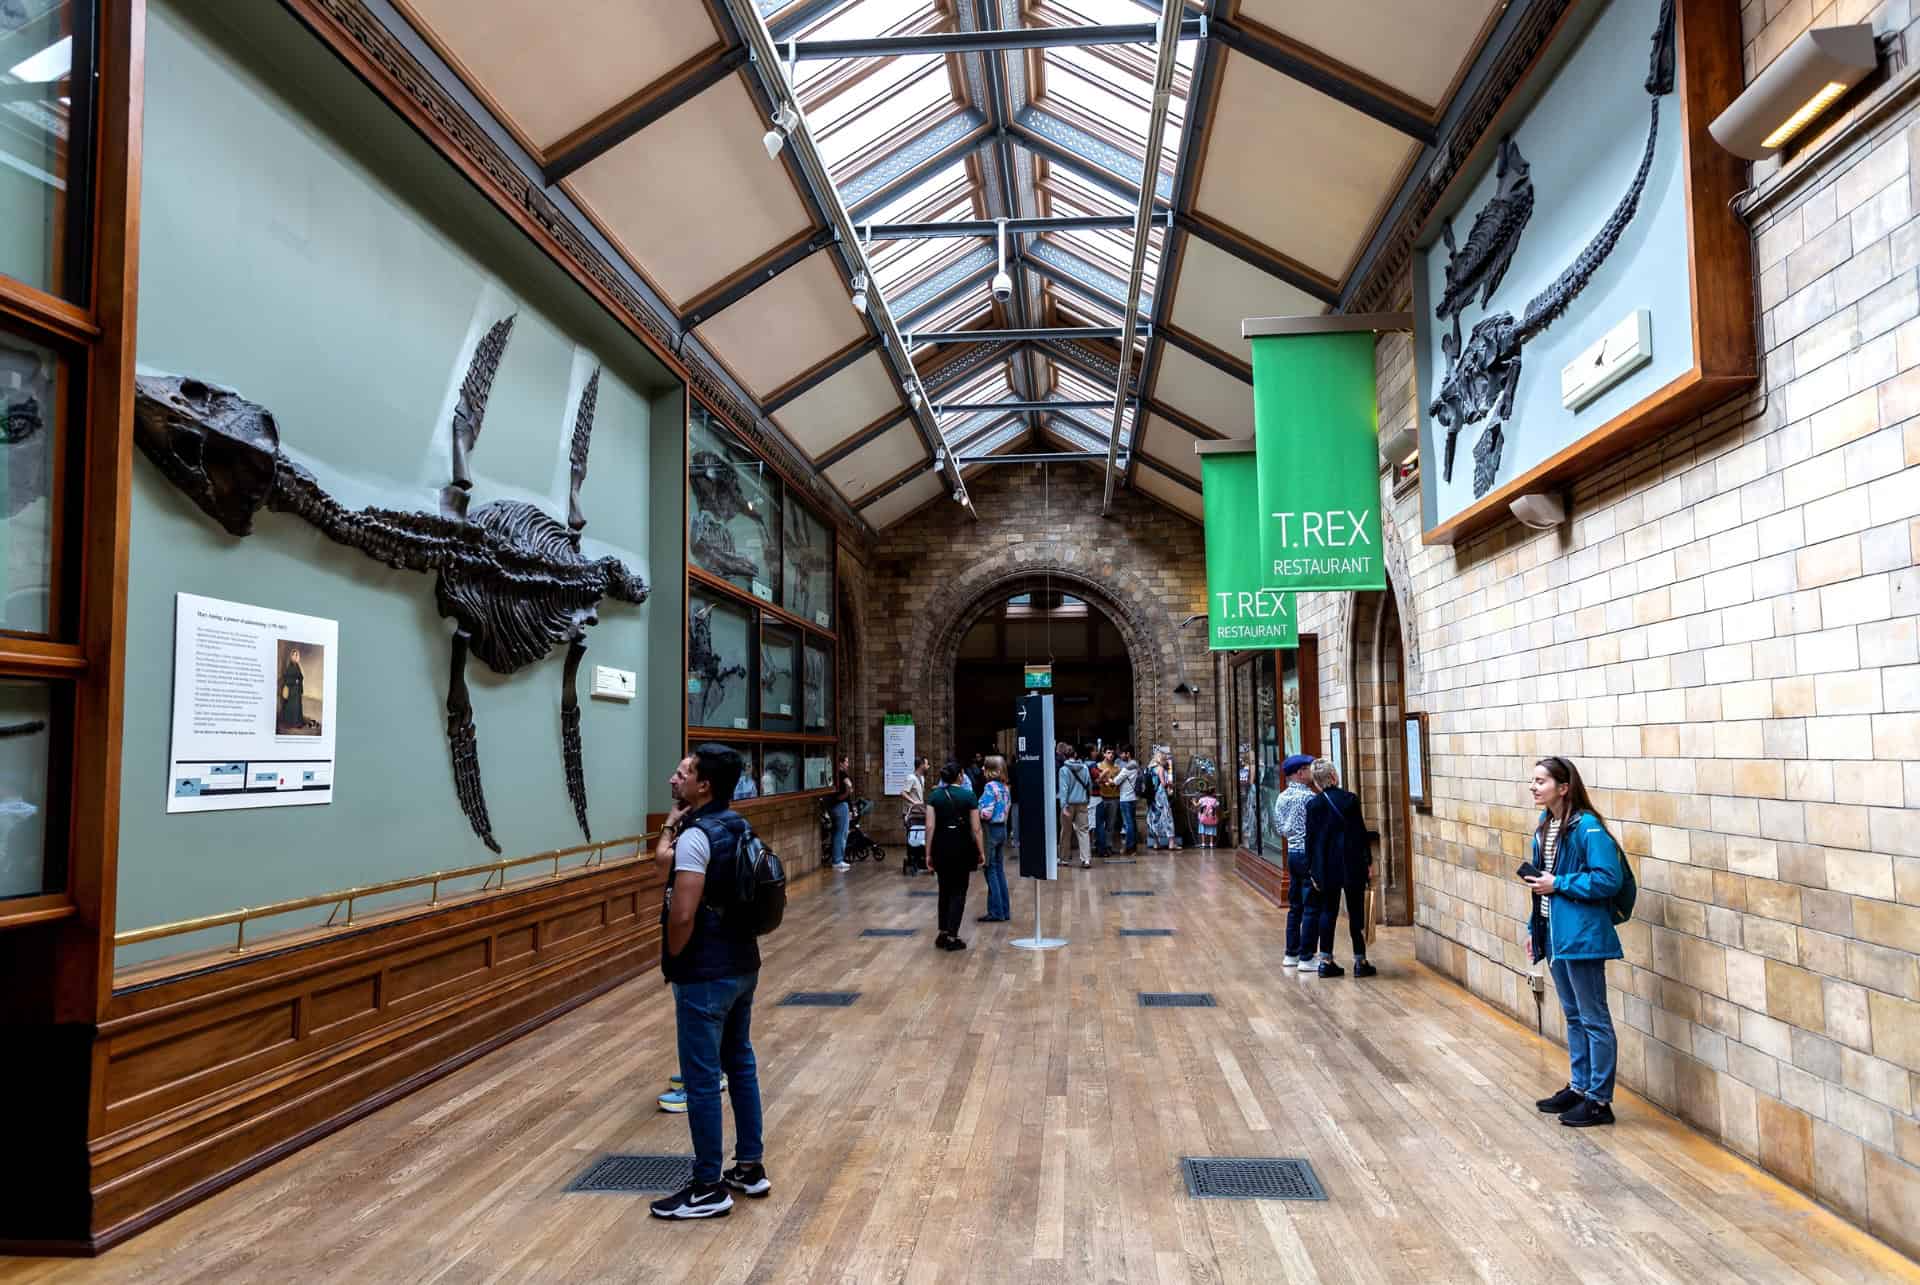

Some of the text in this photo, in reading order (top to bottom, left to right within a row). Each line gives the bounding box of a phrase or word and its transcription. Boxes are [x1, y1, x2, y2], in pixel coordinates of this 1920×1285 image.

[1271, 509, 1371, 548] T.REX
[1273, 556, 1372, 576] RESTAURANT
[1216, 591, 1288, 619] T.REX
[1217, 623, 1288, 639] RESTAURANT
